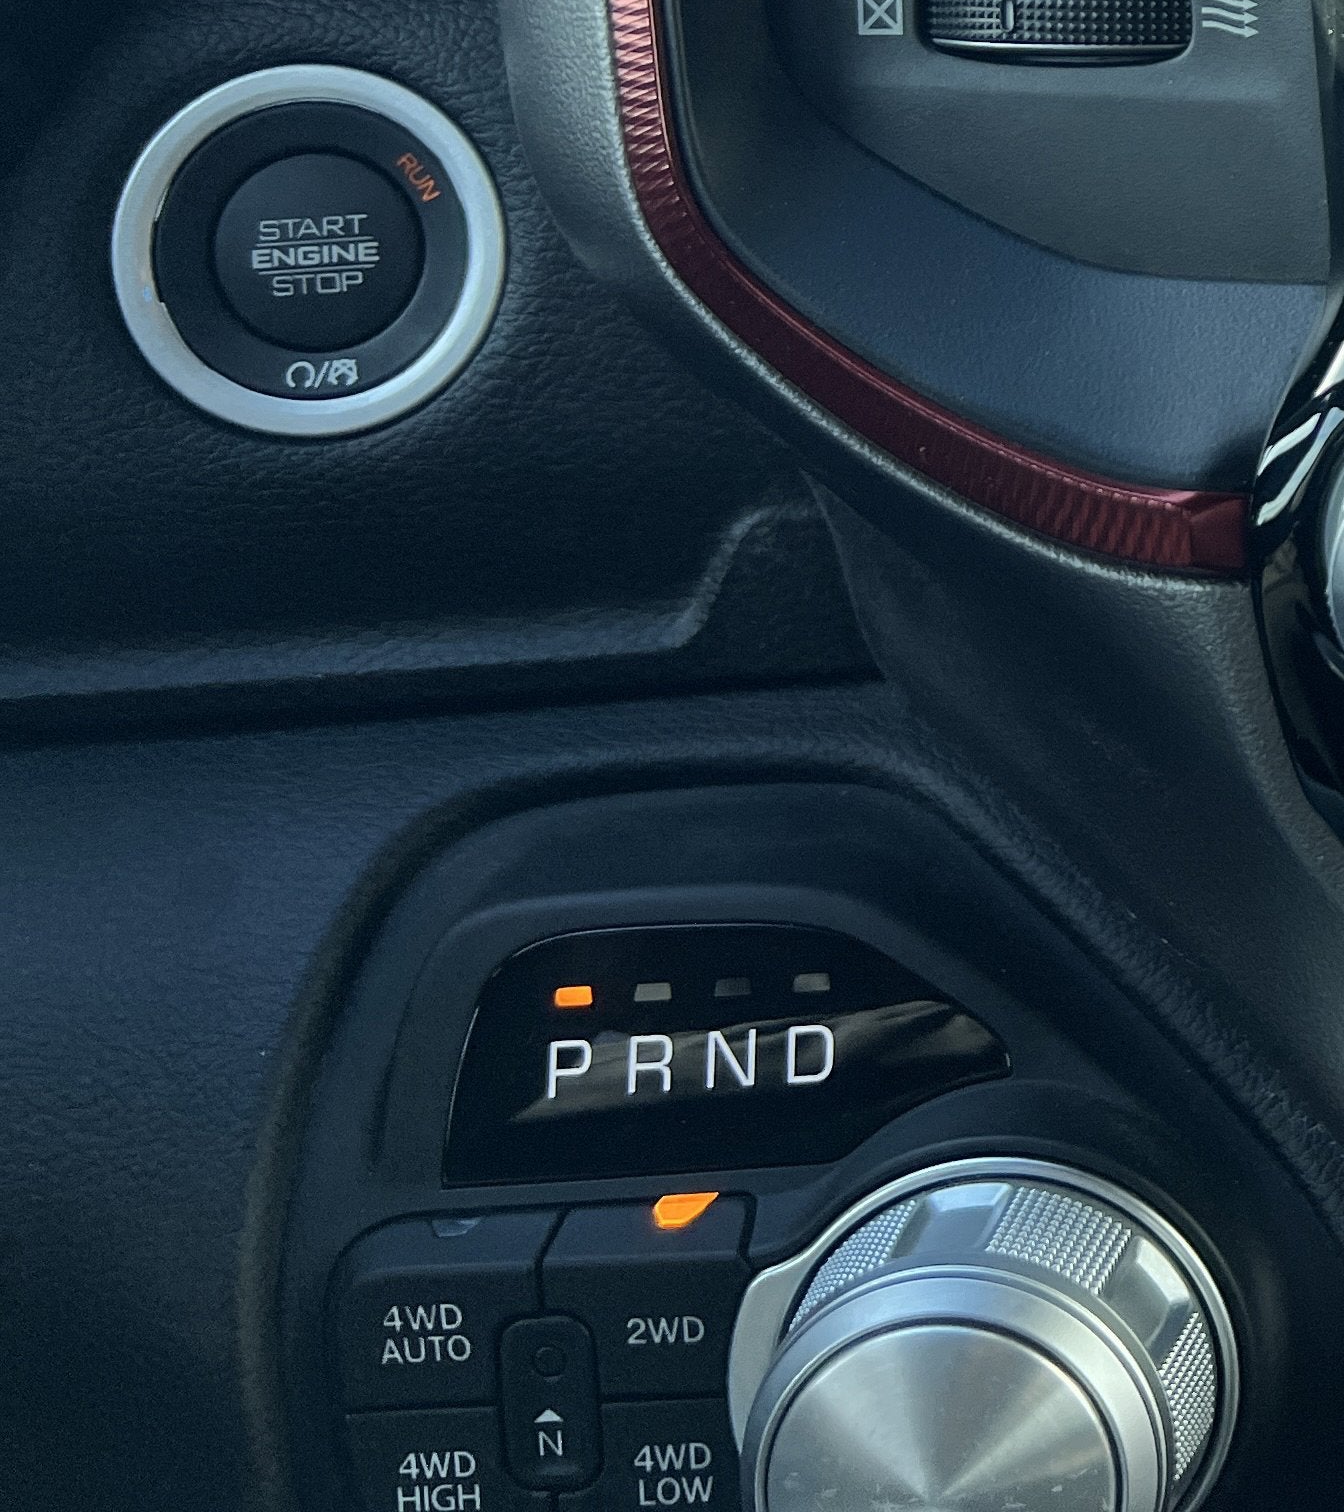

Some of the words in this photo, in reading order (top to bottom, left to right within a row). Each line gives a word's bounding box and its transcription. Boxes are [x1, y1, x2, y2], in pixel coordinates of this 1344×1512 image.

[396, 152, 442, 204] RUN
[259, 214, 369, 242] START
[251, 241, 380, 271] ENGINE
[272, 271, 363, 298] STOP
[547, 1039, 593, 1099] P
[628, 1035, 673, 1095] R
[706, 1029, 757, 1089] N
[787, 1024, 835, 1085] D
[382, 1303, 463, 1332] 4WD
[626, 1316, 705, 1345] 2WD
[381, 1334, 471, 1365] AUTO
[538, 1430, 563, 1458] N
[633, 1442, 712, 1471] 4WD
[399, 1450, 477, 1480] 4WD
[397, 1484, 481, 1512] HIGH
[637, 1476, 713, 1506] LOW
